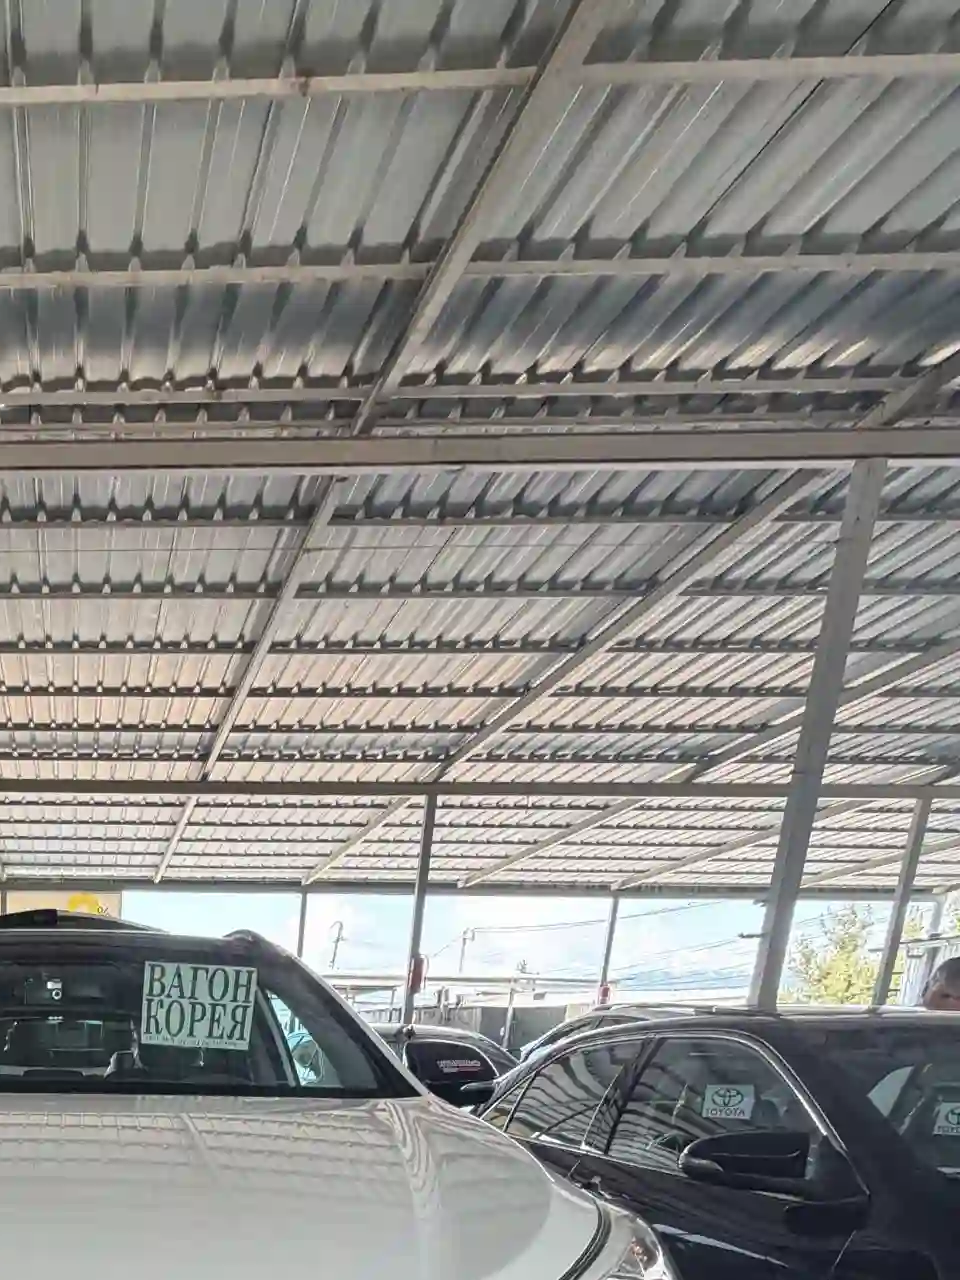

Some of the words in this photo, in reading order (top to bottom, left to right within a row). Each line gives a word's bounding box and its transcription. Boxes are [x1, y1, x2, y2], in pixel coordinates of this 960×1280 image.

[146, 963, 255, 1003] ВАГОН
[144, 998, 252, 1041] КОРЕЯ
[706, 1107, 746, 1117] TOYOTA
